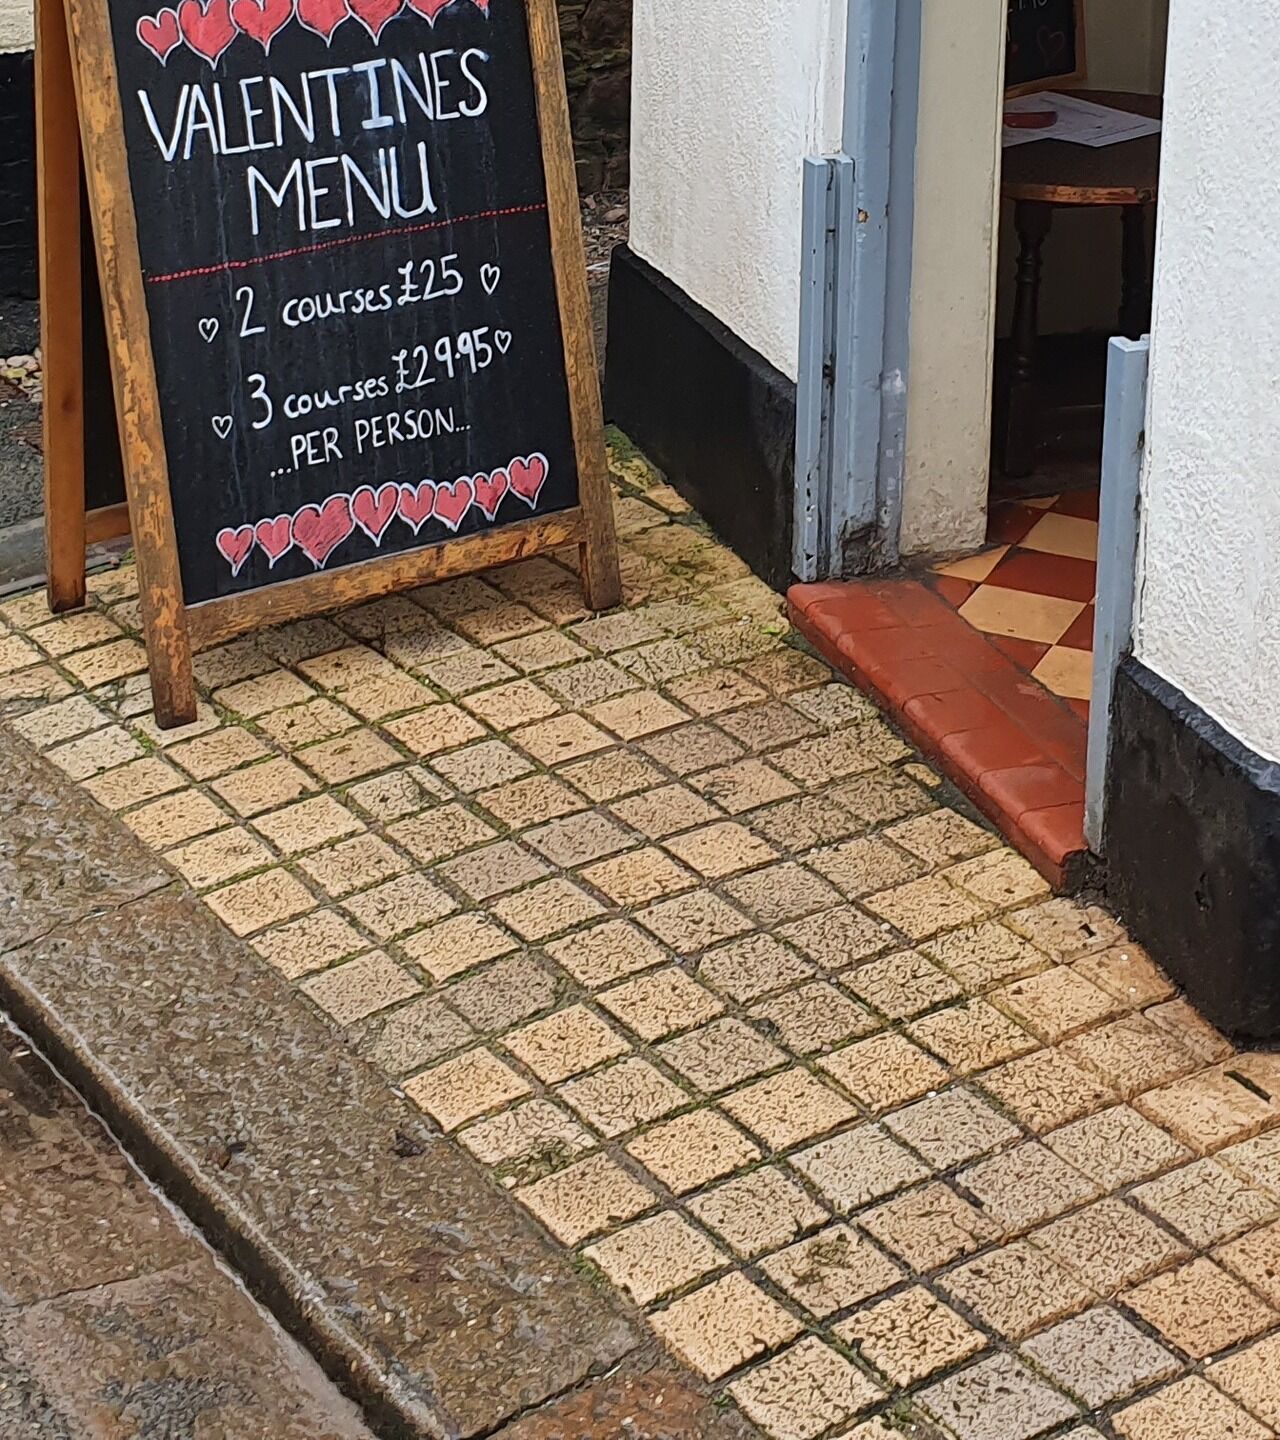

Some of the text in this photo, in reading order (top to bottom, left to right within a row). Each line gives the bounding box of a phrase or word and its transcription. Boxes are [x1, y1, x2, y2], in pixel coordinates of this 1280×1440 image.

[137, 48, 490, 162] VALENTINES
[246, 141, 438, 235] MENU
[235, 253, 464, 339] 2 courses £25
[246, 372, 274, 430] 3
[283, 376, 389, 419] courses
